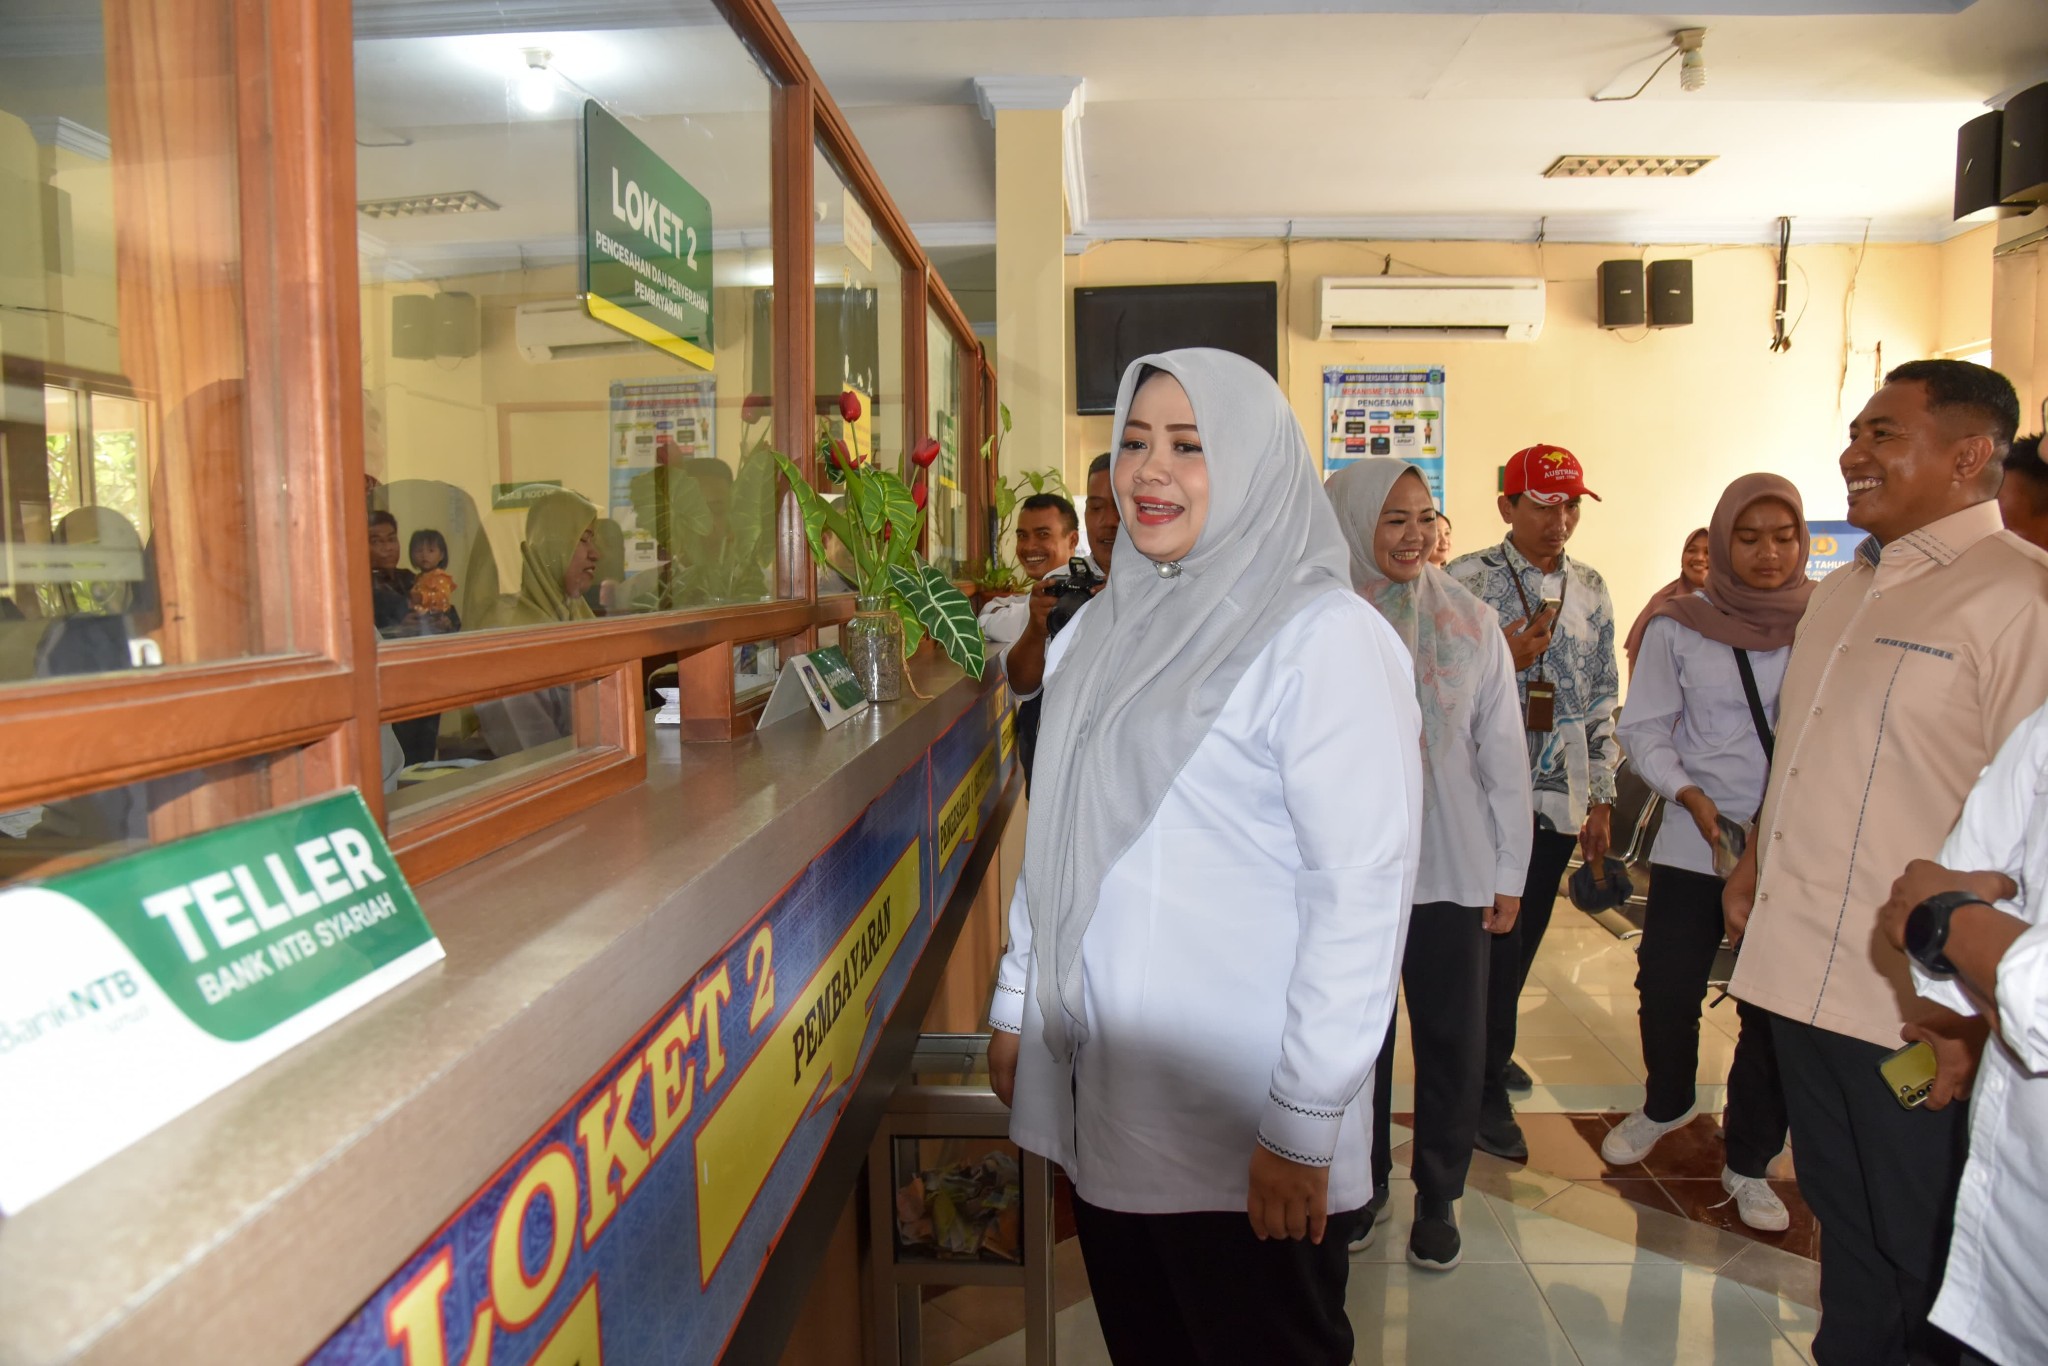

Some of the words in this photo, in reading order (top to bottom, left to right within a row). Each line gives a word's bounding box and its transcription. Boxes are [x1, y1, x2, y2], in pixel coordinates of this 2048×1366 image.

[612, 166, 683, 260] LOKET
[686, 227, 698, 272] 2
[595, 230, 651, 279] PENGESAHAN
[651, 265, 667, 289] DAN
[667, 276, 709, 315] PENYERAHAN
[634, 279, 683, 322] PEMBAYARAN
[1342, 387, 1382, 395] MEKANISME
[1384, 387, 1425, 395] PELAYANAN
[1346, 373, 1365, 382] KANTOR
[1366, 373, 1389, 382] BERSAMA
[1357, 399, 1414, 407] PENGESAHAN
[1544, 468, 1579, 479] AUSTRALIA
[141, 827, 386, 963] TELLER
[196, 949, 274, 1005] BANK
[267, 929, 318, 971] NTB
[313, 891, 398, 947] SYARIAH
[792, 894, 891, 1086] PEMBAYARAN
[384, 958, 732, 1366] LOKET
[747, 921, 775, 1036] 2
